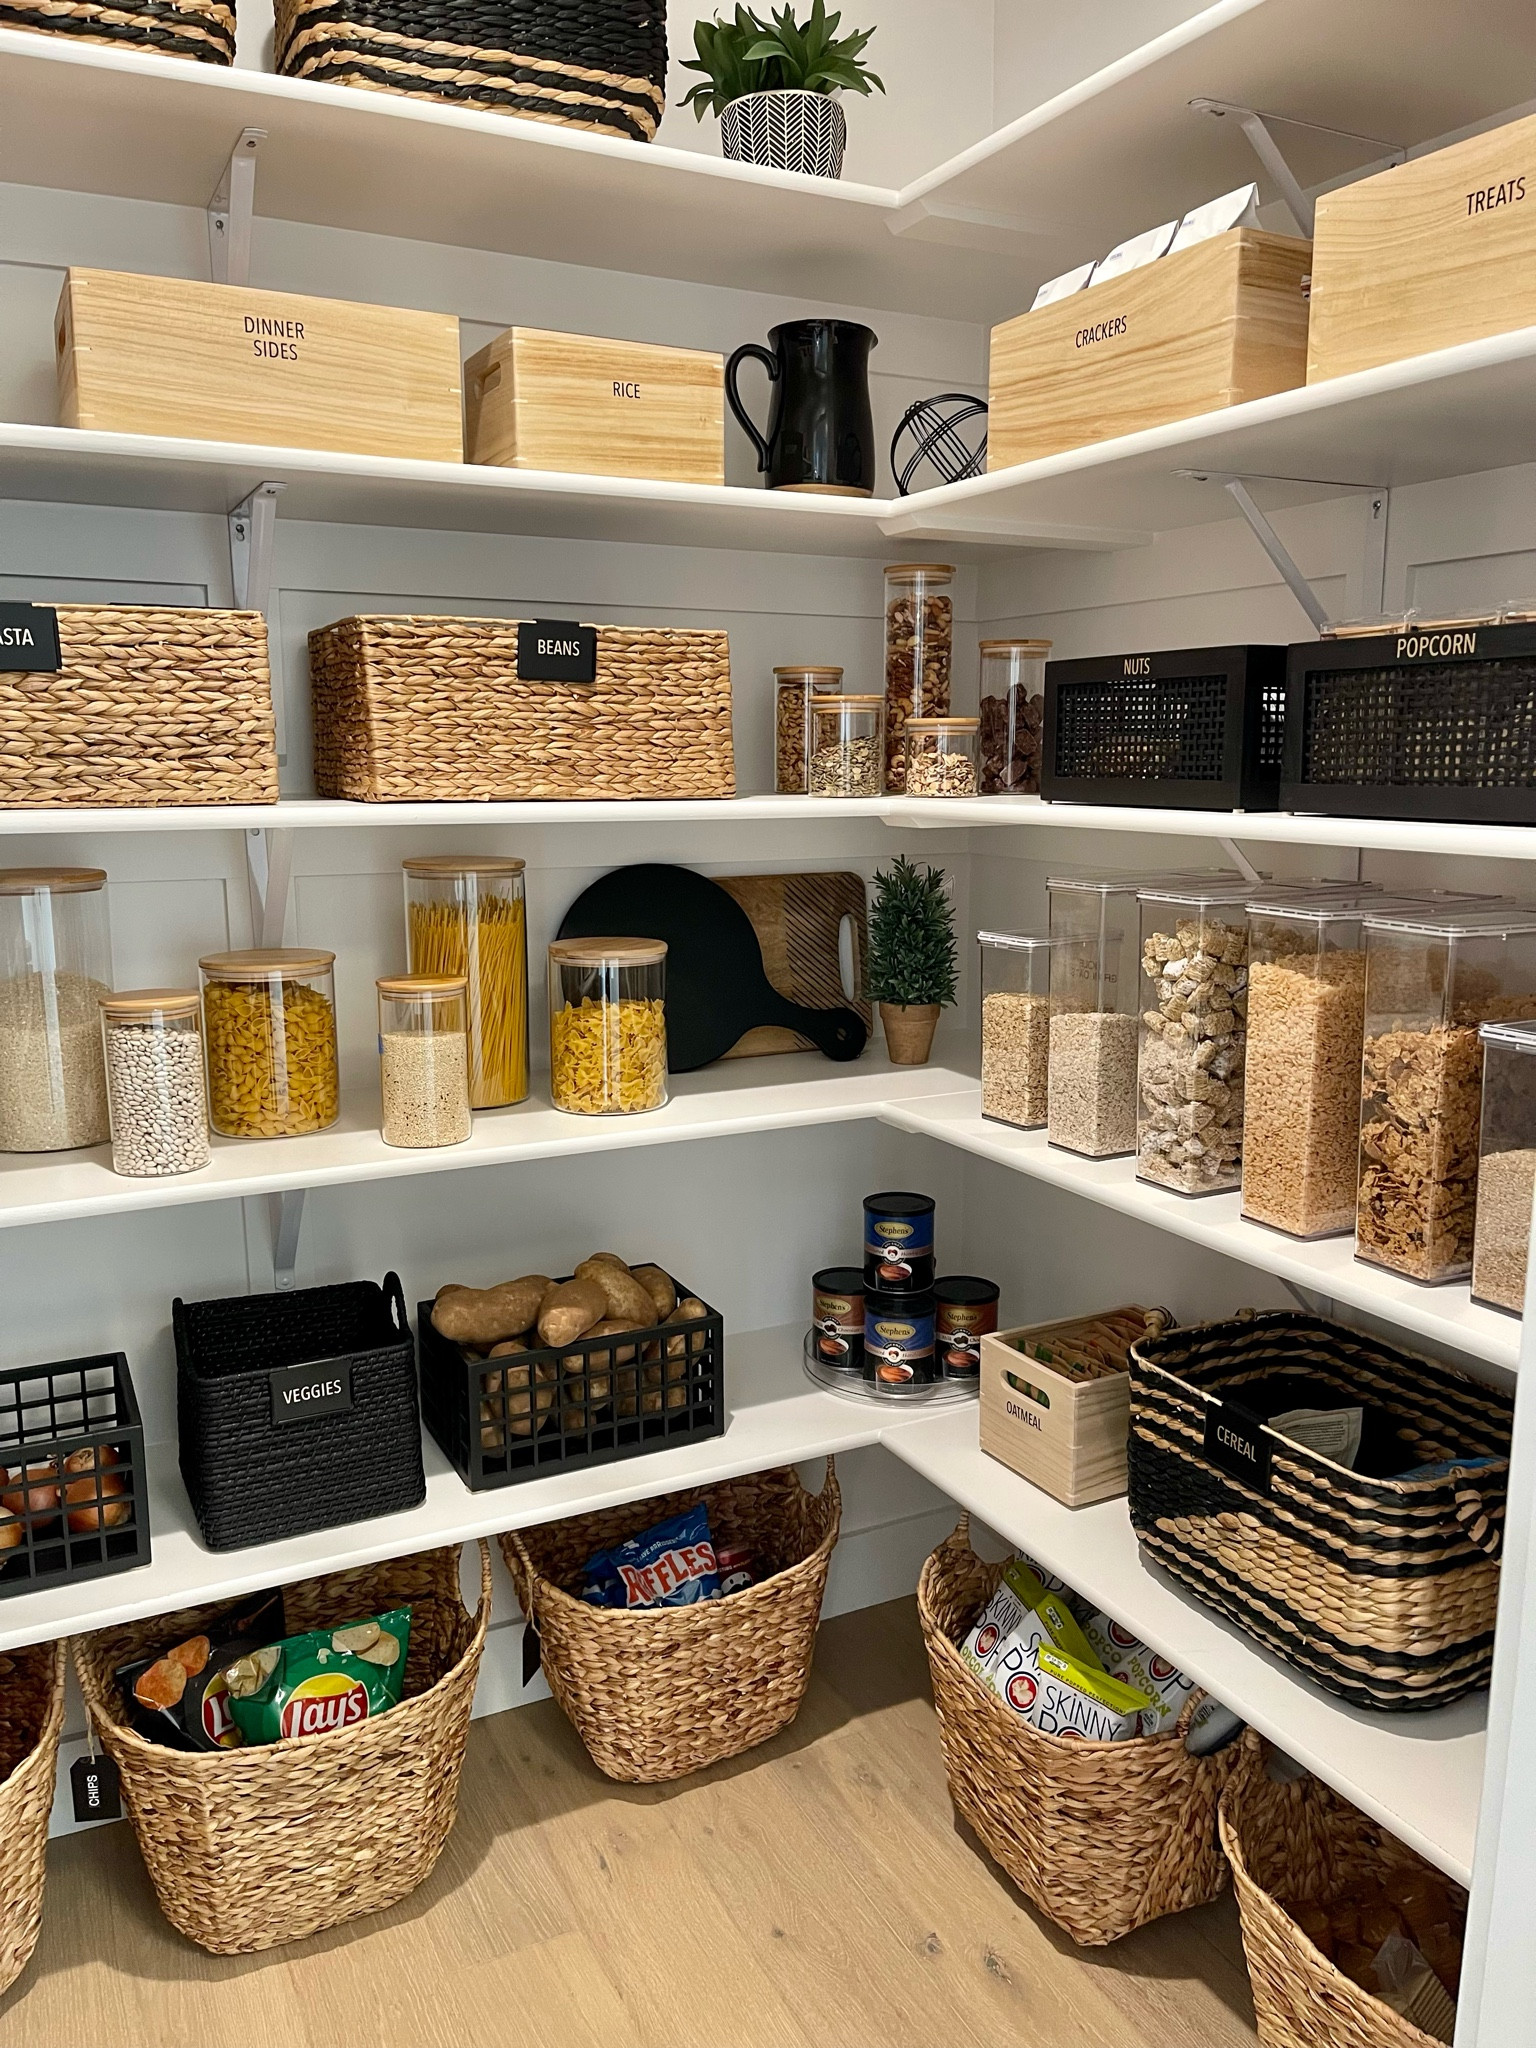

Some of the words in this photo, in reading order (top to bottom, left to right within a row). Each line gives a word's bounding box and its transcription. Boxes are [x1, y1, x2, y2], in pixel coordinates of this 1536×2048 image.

[1466, 176, 1526, 216] TREATS
[244, 316, 305, 339] DINNER
[1075, 315, 1127, 349] CRACKERS
[253, 339, 298, 361] SIDES
[613, 381, 641, 399] RICE
[537, 639, 580, 657] BEANS
[1396, 632, 1477, 659] POPCORN
[1123, 657, 1151, 676] NUTS
[282, 1379, 342, 1405] VEGGIES
[1006, 1401, 1042, 1432] OATMEAL
[1216, 1425, 1257, 1464] CEREAL
[1084, 1621, 1123, 1665] POPCO
[1049, 1669, 1064, 1681] PURE
[1065, 1676, 1087, 1693] POPPED
[86, 1774, 100, 1807] CHIPS
